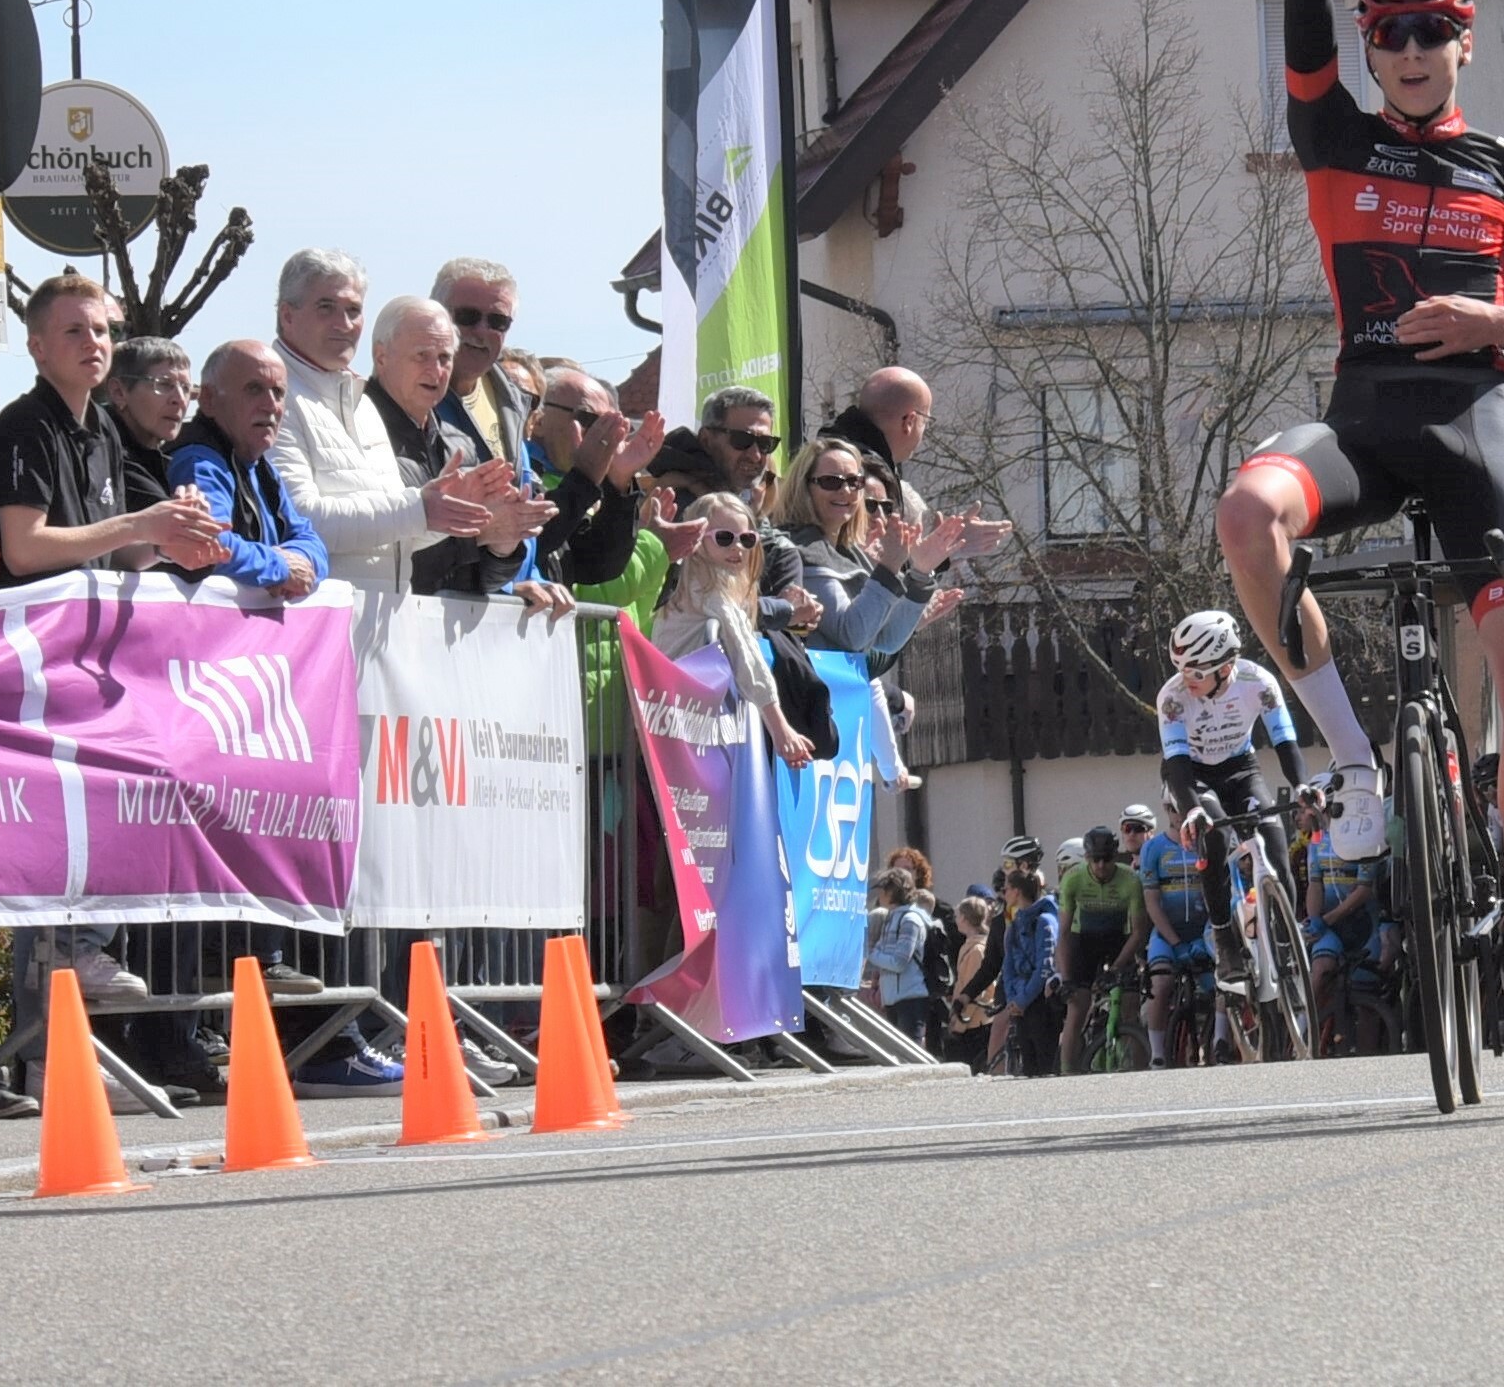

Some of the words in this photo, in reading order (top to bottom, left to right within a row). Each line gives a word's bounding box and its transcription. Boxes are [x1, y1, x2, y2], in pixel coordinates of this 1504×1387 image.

[1385, 199, 1482, 224] Sparkasse
[468, 718, 495, 759] Veit
[222, 787, 259, 834] DIE
